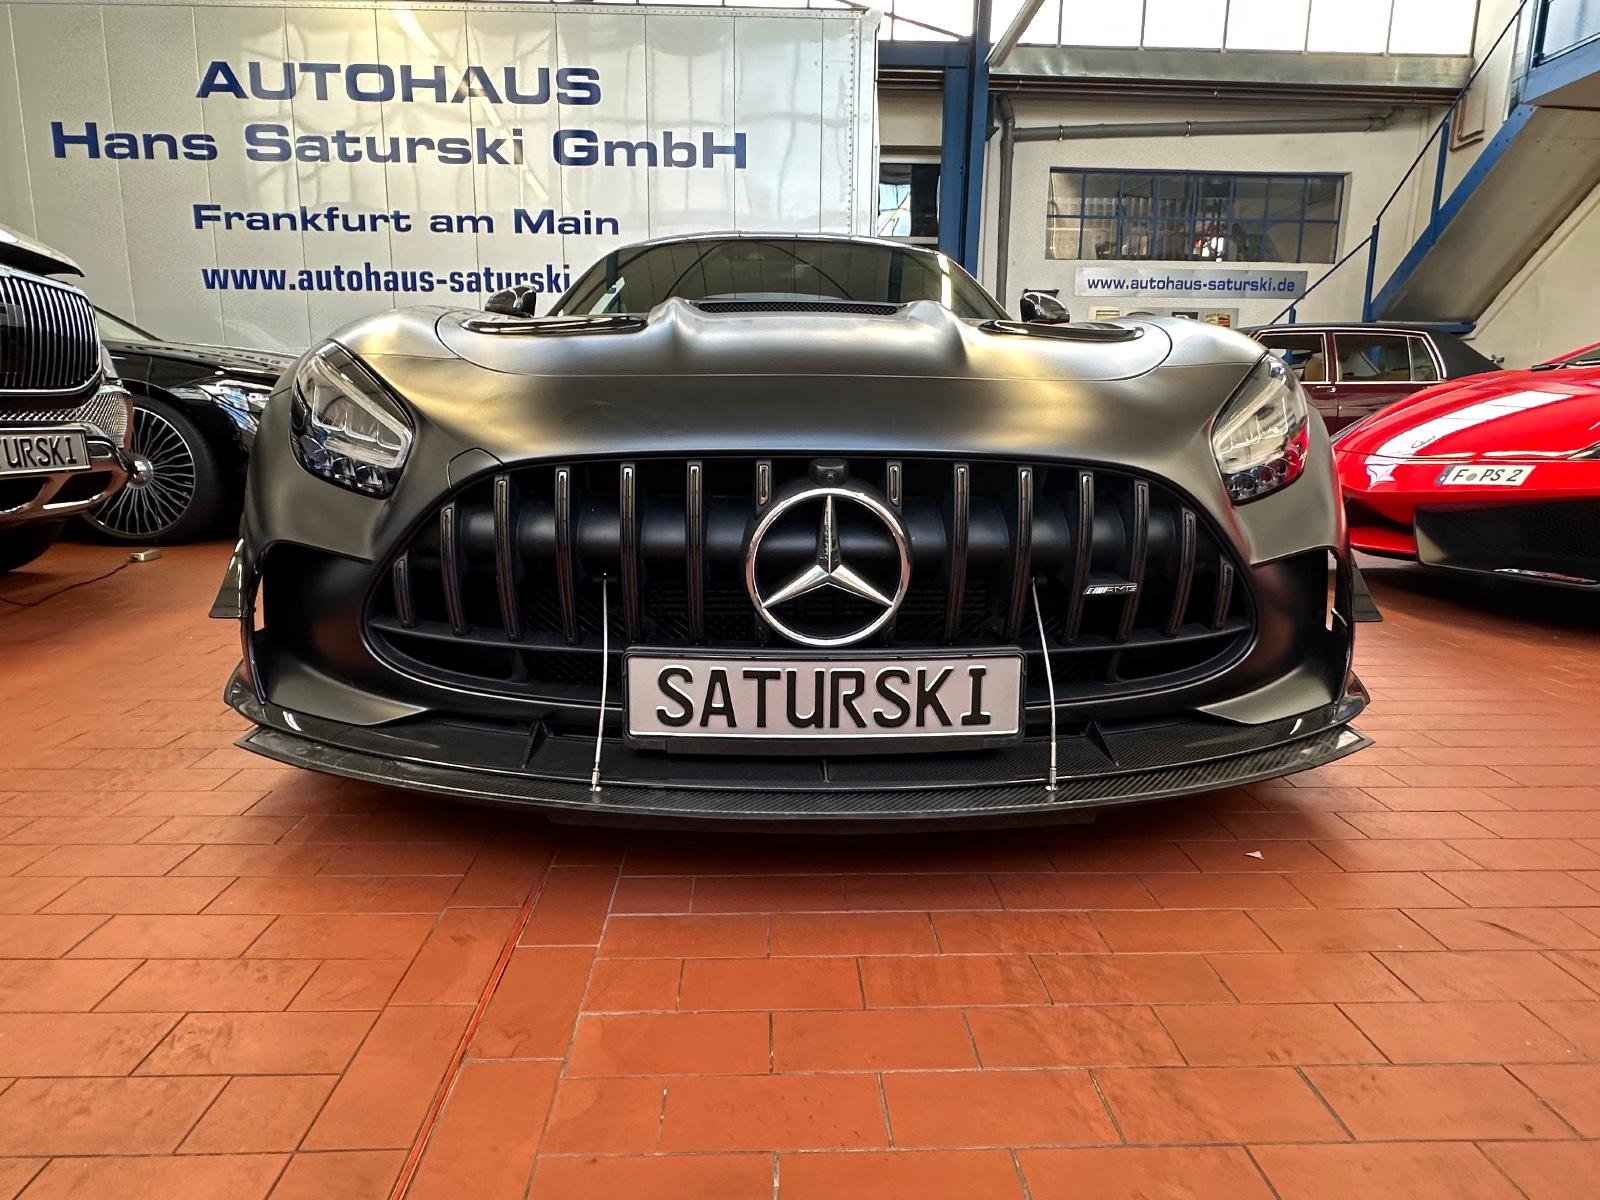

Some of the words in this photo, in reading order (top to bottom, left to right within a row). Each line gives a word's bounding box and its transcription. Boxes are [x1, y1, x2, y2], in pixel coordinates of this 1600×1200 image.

[196, 61, 602, 106] AUTOHAUS
[50, 121, 218, 161] Hans
[244, 123, 525, 165] Saturski
[552, 128, 748, 170] GmbH
[193, 204, 412, 232] Frankfurt
[430, 213, 494, 234] am
[513, 208, 620, 236] Main
[201, 262, 571, 294] www.autohaus-saturski
[1087, 275, 1296, 293] www.autohaus-saturski.de
[0, 436, 78, 469] URSKI
[1452, 468, 1470, 482] F
[1479, 468, 1506, 482] PS
[1505, 468, 1524, 482] 2
[656, 665, 992, 729] SATURSKI
